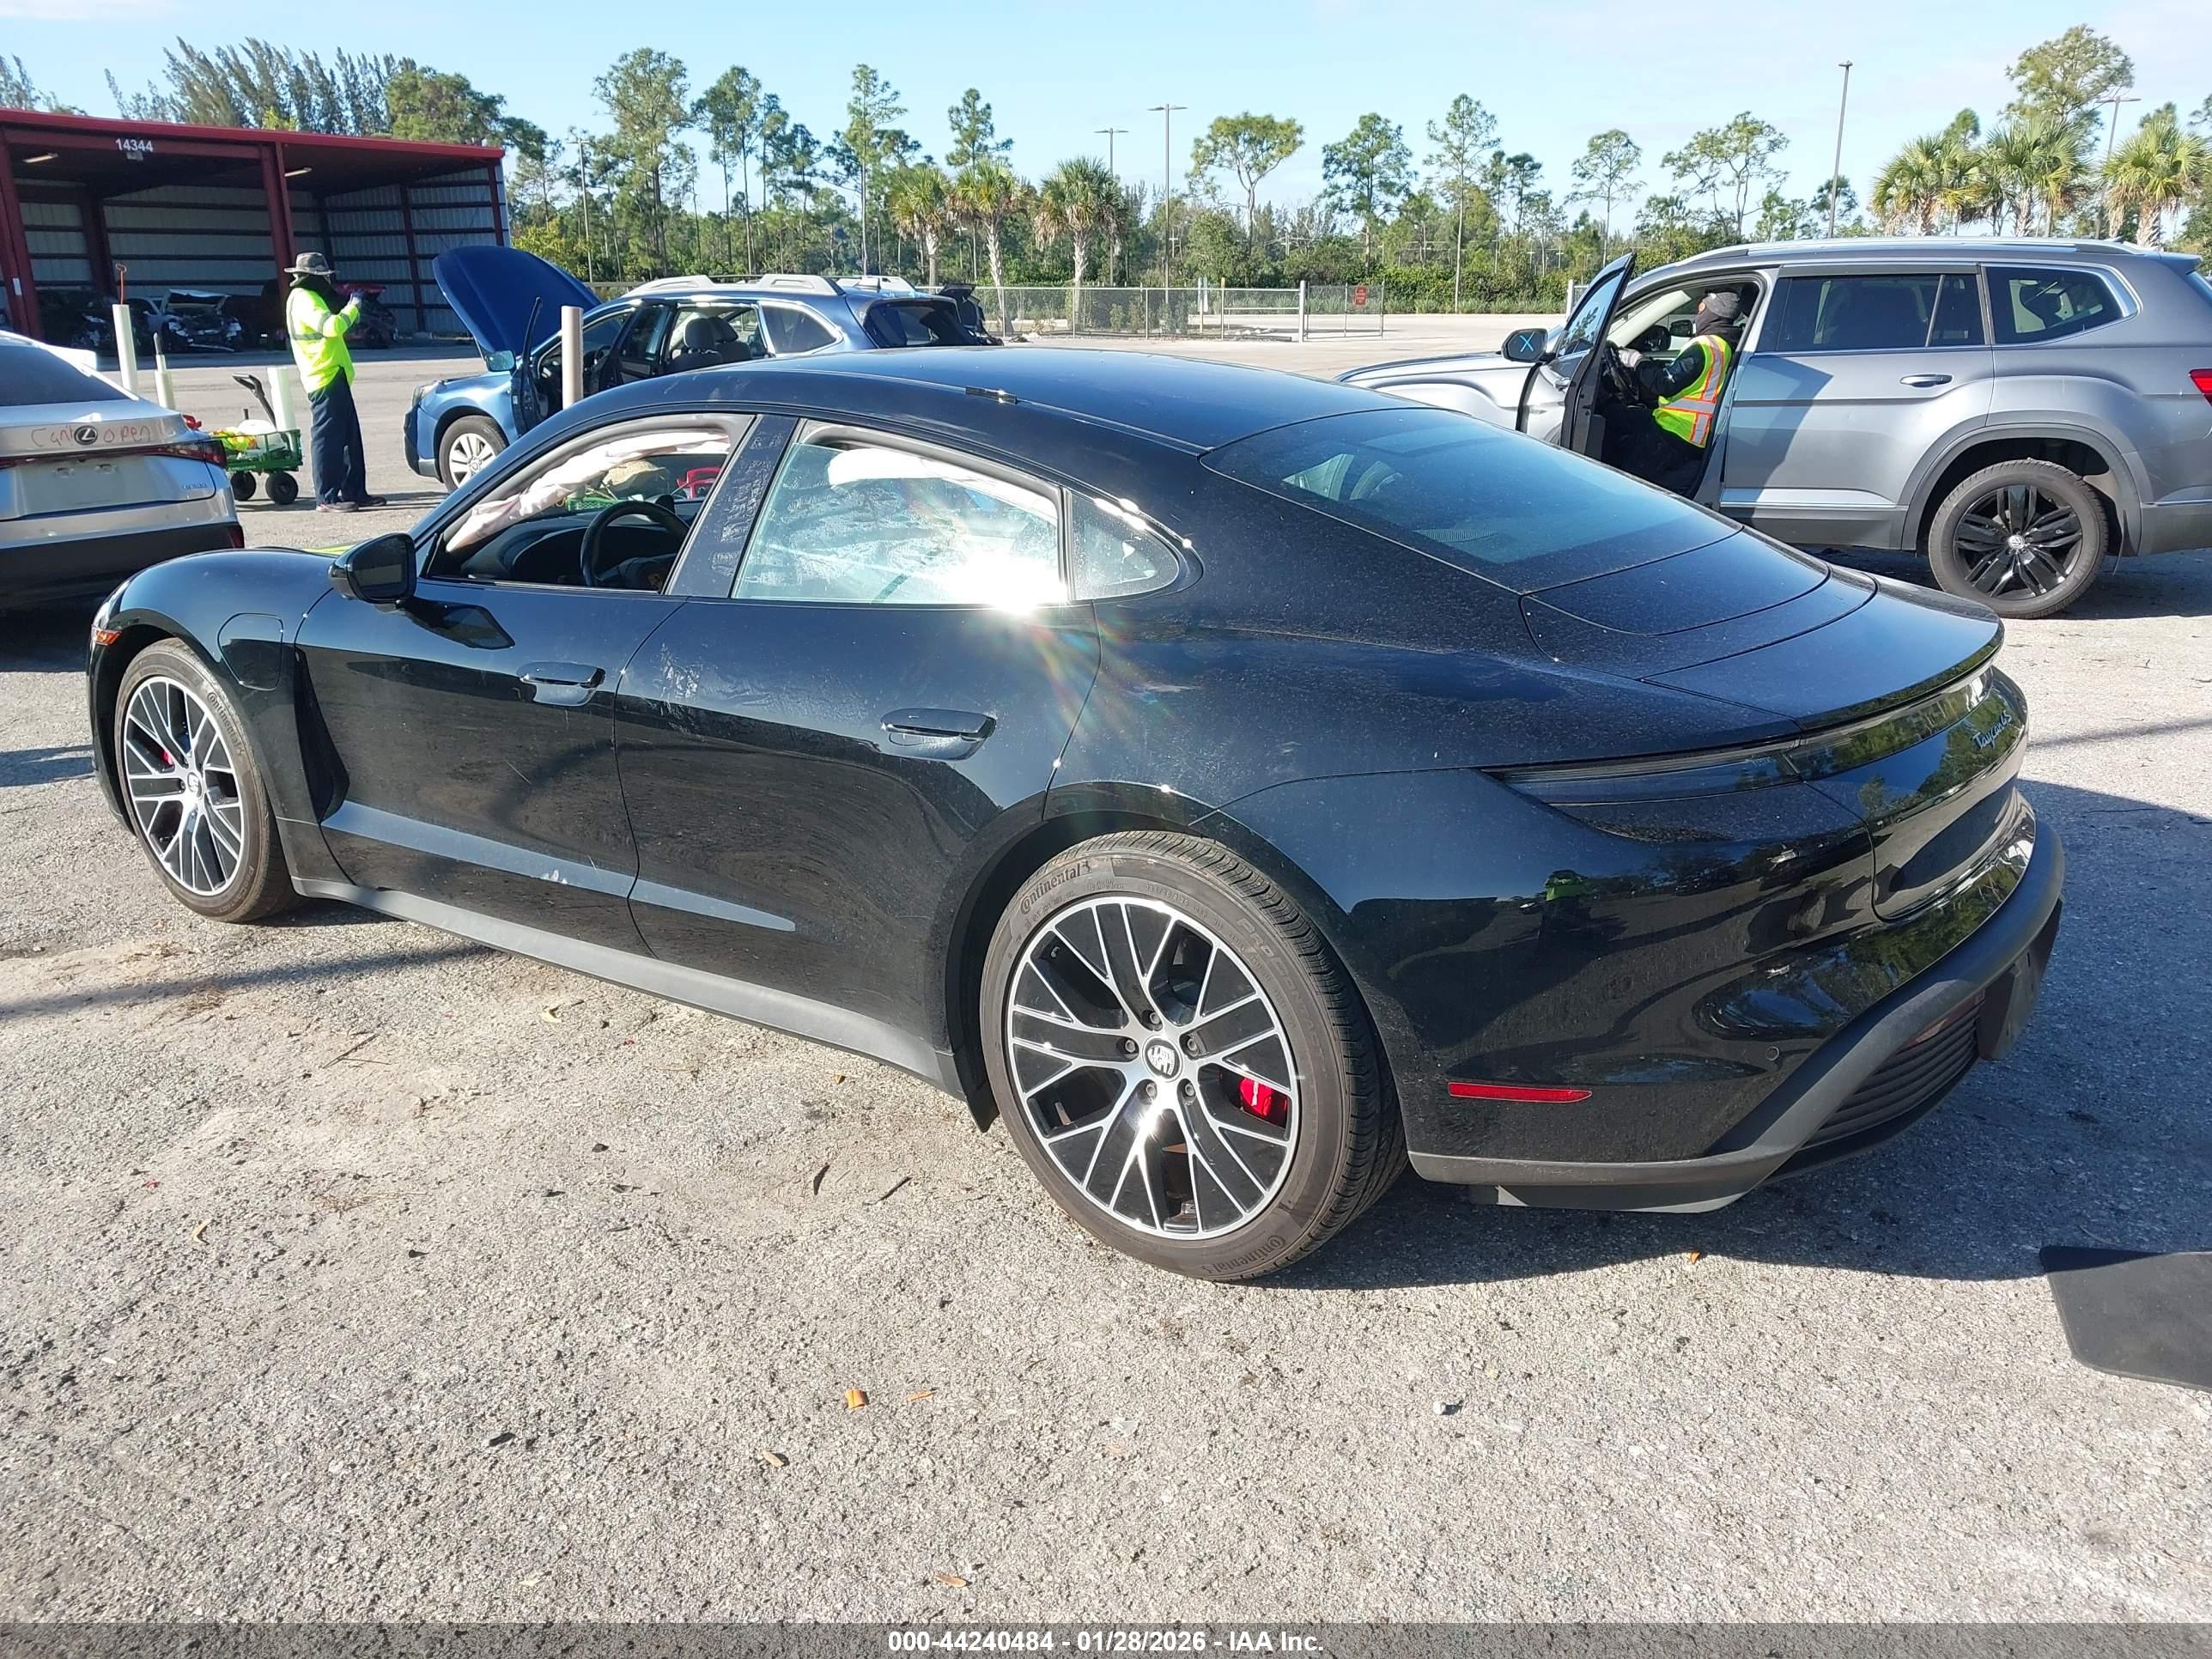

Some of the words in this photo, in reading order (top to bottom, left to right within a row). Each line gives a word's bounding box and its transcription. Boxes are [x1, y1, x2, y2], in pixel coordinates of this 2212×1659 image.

[115, 137, 154, 153] 14344
[207, 691, 242, 748] Continental
[1020, 861, 1081, 915] Continental
[1212, 1234, 1286, 1273] Continental
